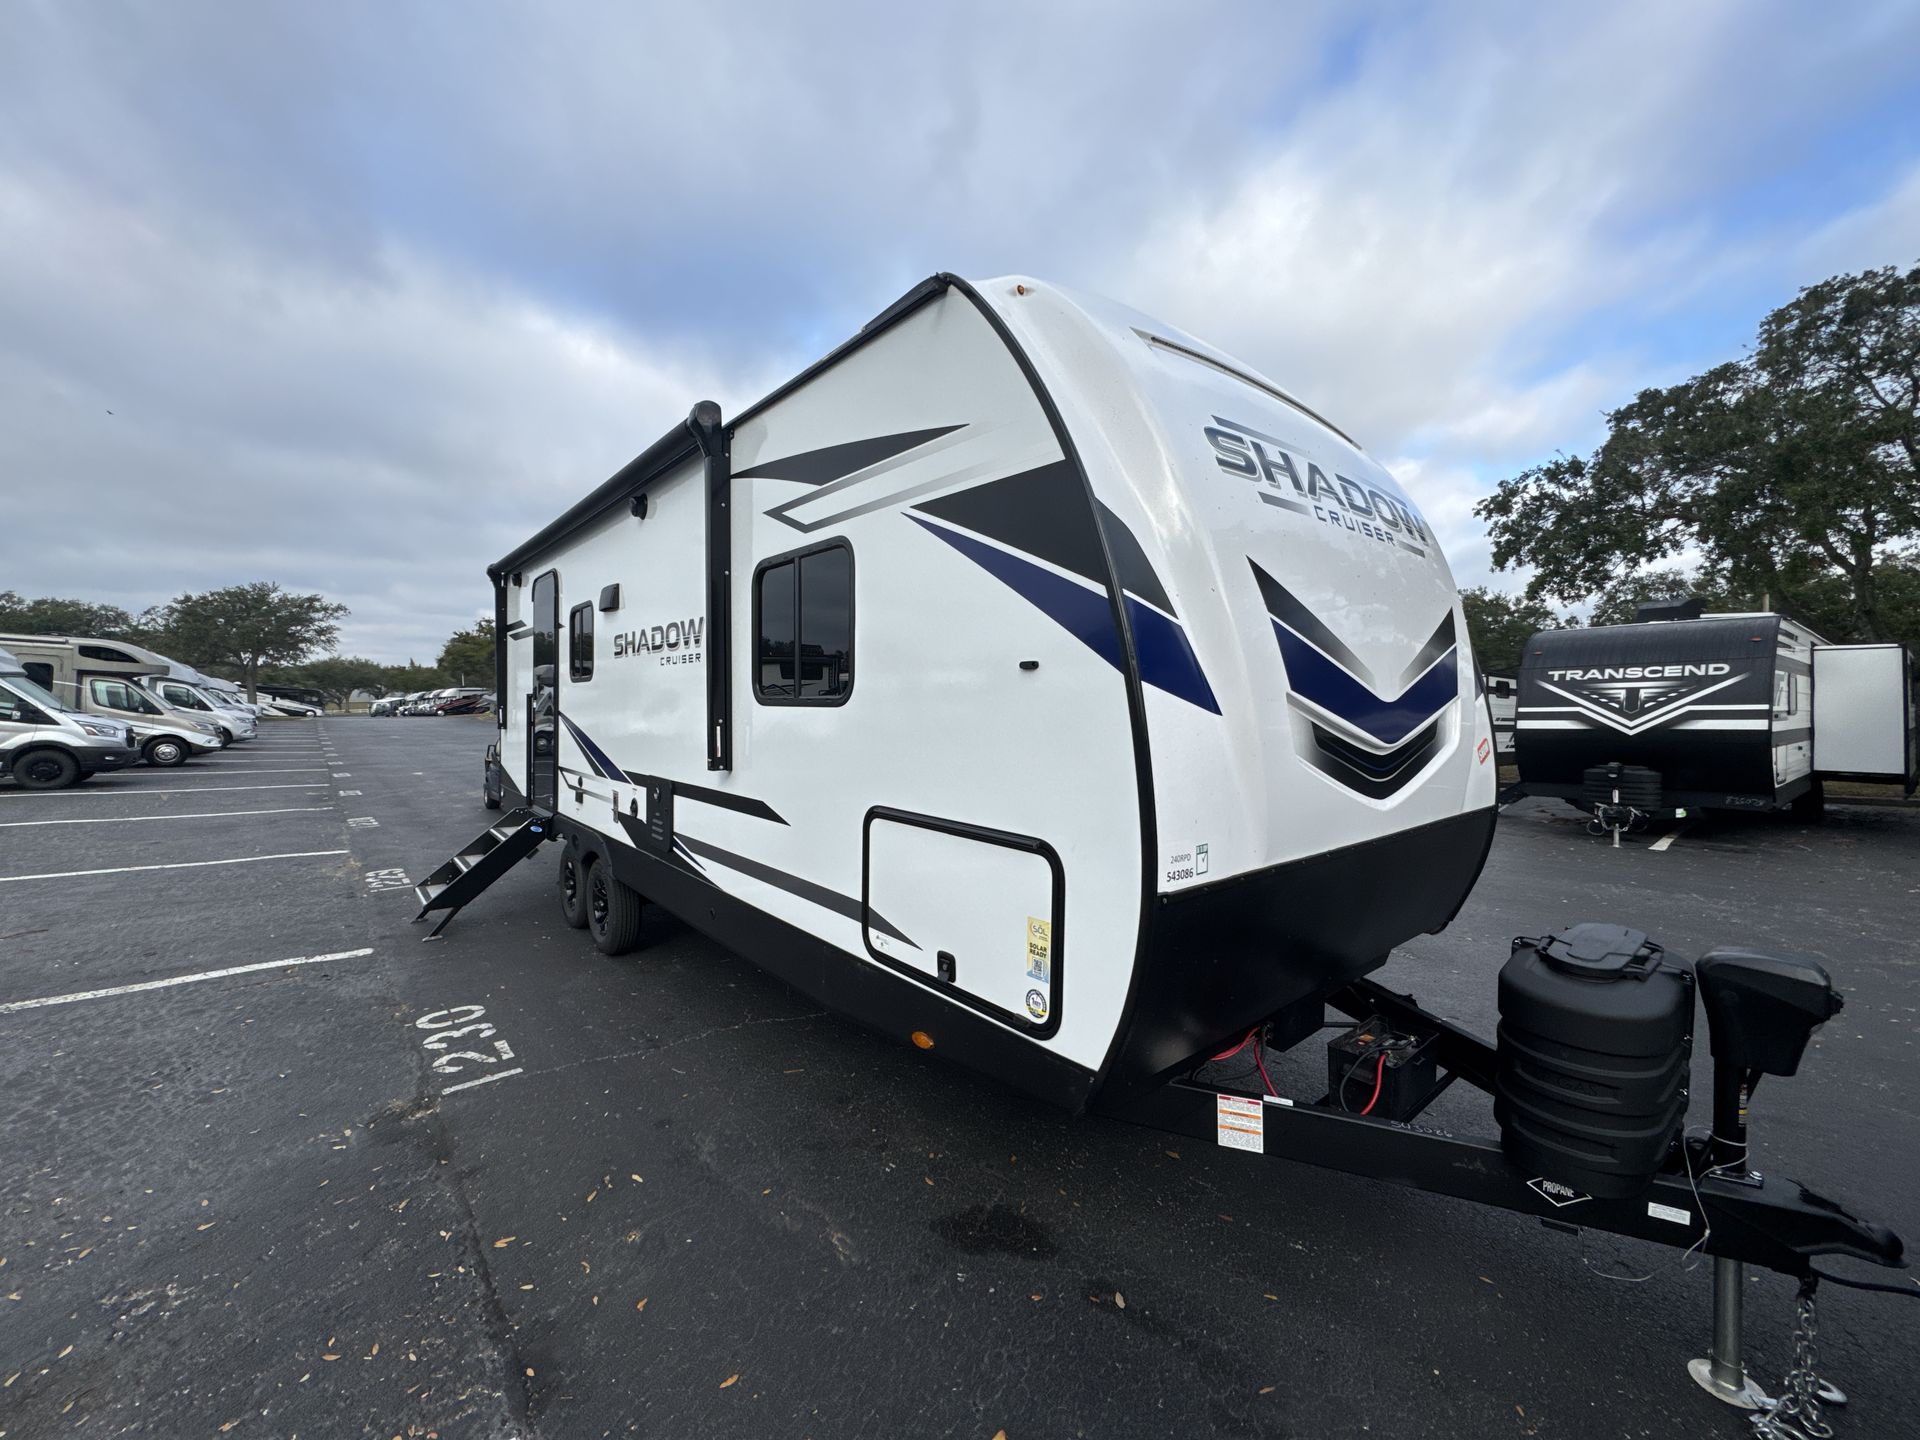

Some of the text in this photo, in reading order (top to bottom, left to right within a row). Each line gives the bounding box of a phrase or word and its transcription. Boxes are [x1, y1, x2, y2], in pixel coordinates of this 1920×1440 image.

[1203, 426, 1430, 547] SHADOW
[1313, 504, 1396, 547] CRUISER
[613, 616, 705, 658] SHADOW
[659, 652, 702, 667] CRUISER
[1547, 662, 1731, 682] TRANSCEND
[1166, 867, 1194, 882] 543086
[1029, 942, 1048, 953] SOLAR
[1029, 948, 1048, 959] READY
[415, 1004, 524, 1096] 1230
[1542, 1180, 1575, 1198] PROPANE
